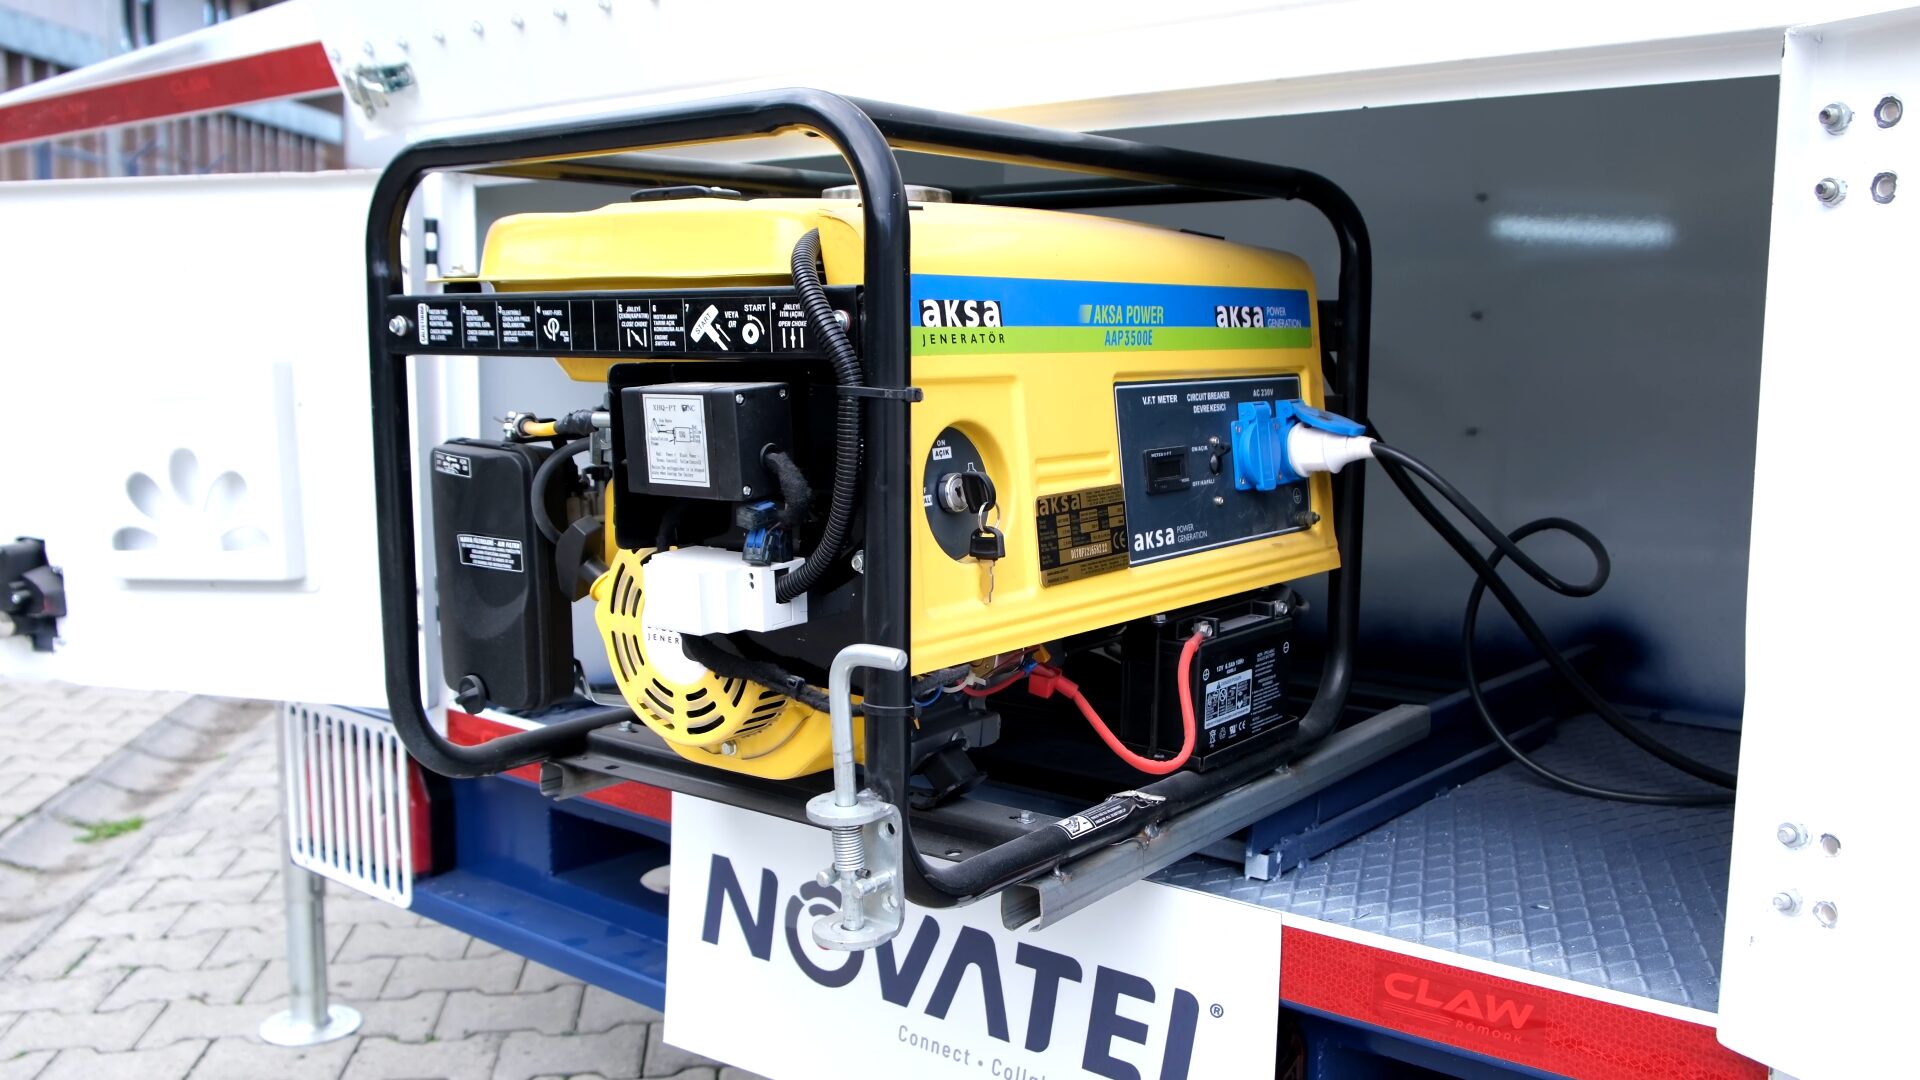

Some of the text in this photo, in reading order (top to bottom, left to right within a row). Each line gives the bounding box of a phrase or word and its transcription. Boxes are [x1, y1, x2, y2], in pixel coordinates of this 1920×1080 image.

[462, 305, 467, 314] 2
[498, 305, 502, 314] 3
[619, 304, 622, 312] 5
[652, 304, 657, 312] 6
[685, 304, 690, 312] 7
[744, 304, 766, 312] START
[772, 302, 776, 310] 8
[922, 299, 1000, 327] aksa
[1094, 305, 1164, 324] AKSA POWER
[1216, 306, 1263, 327] aksa
[1267, 307, 1286, 316] POWER
[695, 312, 712, 334] START
[1268, 319, 1302, 328] GENERATION
[922, 331, 1005, 347] JENERATÖR
[1105, 330, 1152, 346] AAP3500E
[1187, 391, 1230, 402] CIRCUIT BREAKER
[1253, 388, 1274, 397] AC 230V
[1157, 394, 1177, 404] METER
[1193, 403, 1210, 414] DEVRE
[936, 439, 946, 447] ON
[934, 449, 950, 459] AÇIK
[1039, 494, 1080, 516] aksa
[1176, 524, 1194, 533] POWER
[1134, 527, 1175, 552] aksa
[1177, 532, 1208, 543] GENERATION
[647, 633, 680, 645] JENER
[1384, 972, 1535, 1030] CLAW
[898, 1025, 970, 1066] Connect
